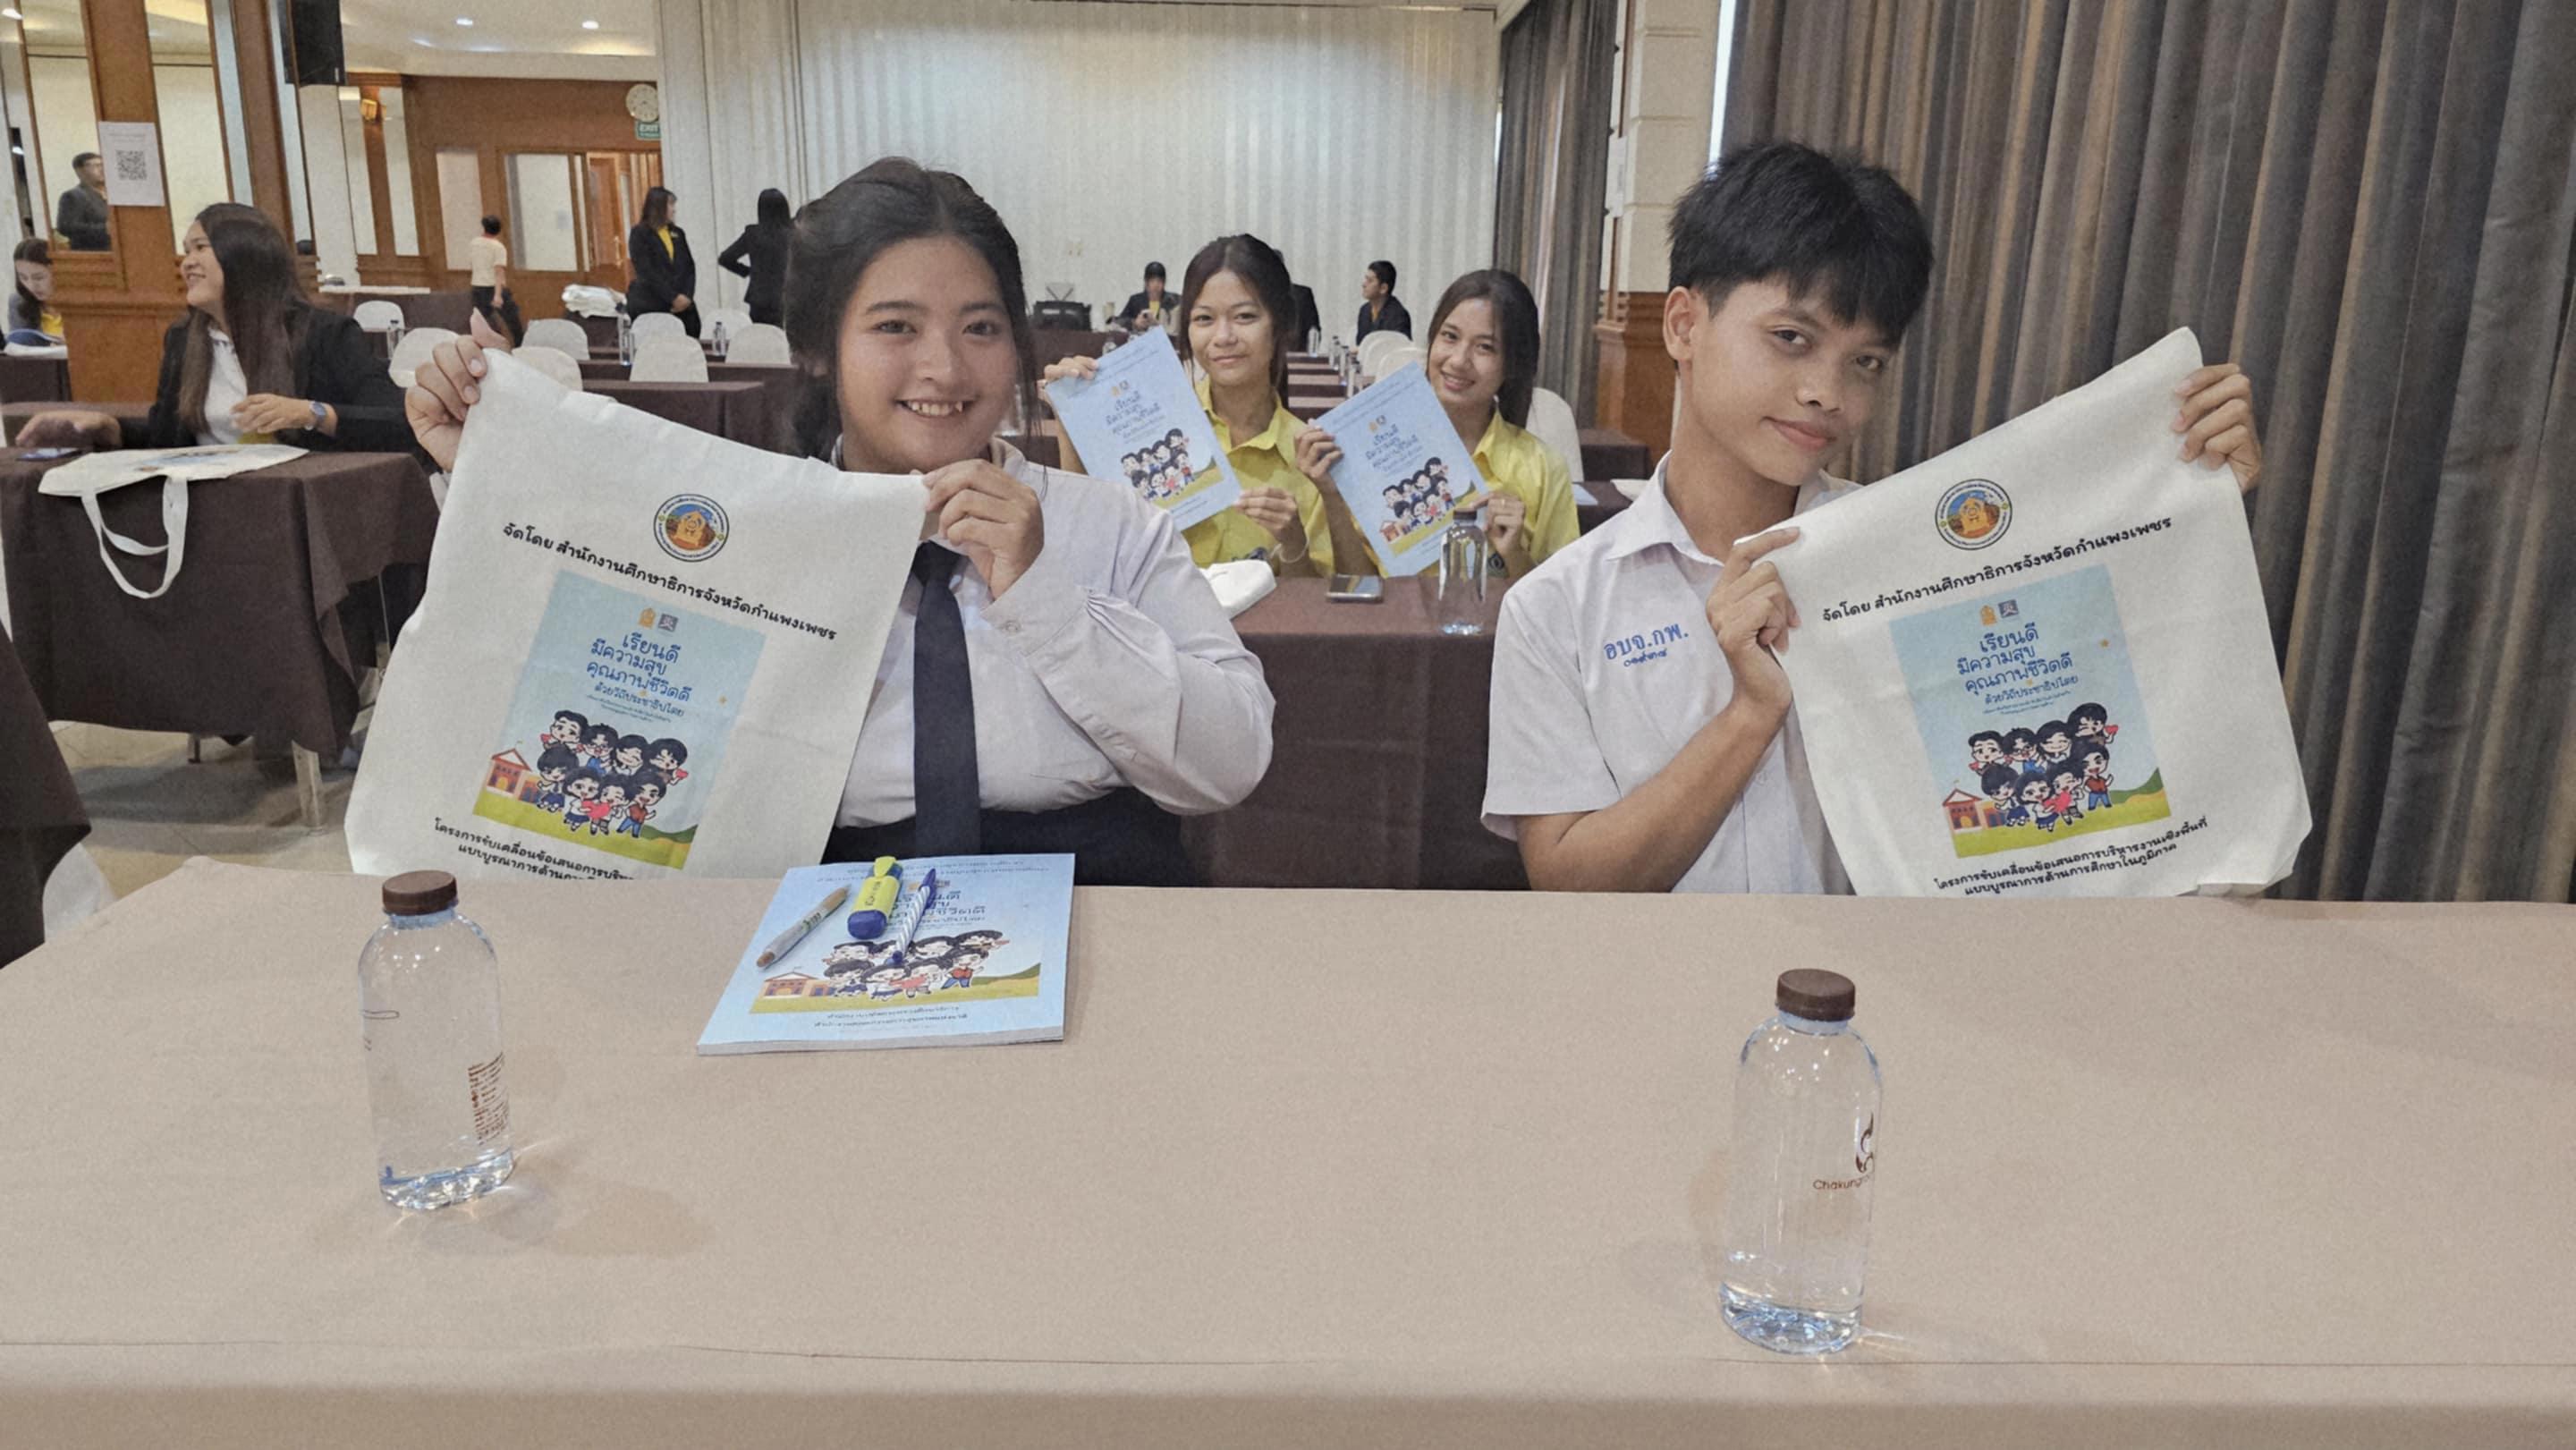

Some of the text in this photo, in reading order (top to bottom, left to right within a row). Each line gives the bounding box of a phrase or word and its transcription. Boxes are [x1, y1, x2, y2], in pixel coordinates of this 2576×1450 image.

[503, 522, 554, 549] จัดโดย
[555, 540, 837, 640] สำนักงานศึกษาธิการจังหวัดกำแพงเพชร
[1822, 600, 1871, 622] จัดโดย
[1874, 516, 2173, 609] สำนักงานศึกษาธิการจังหวัดกำแพงเพชร
[623, 632, 682, 664] เรียนดี
[1979, 622, 2039, 653] เรียนดี
[590, 639, 667, 676] มีความสุข
[1956, 645, 2036, 675] มีความสุข
[1964, 651, 2073, 695] คุณภาพชีวิตดี
[587, 660, 692, 702] คุณภาพชีวิตดี
